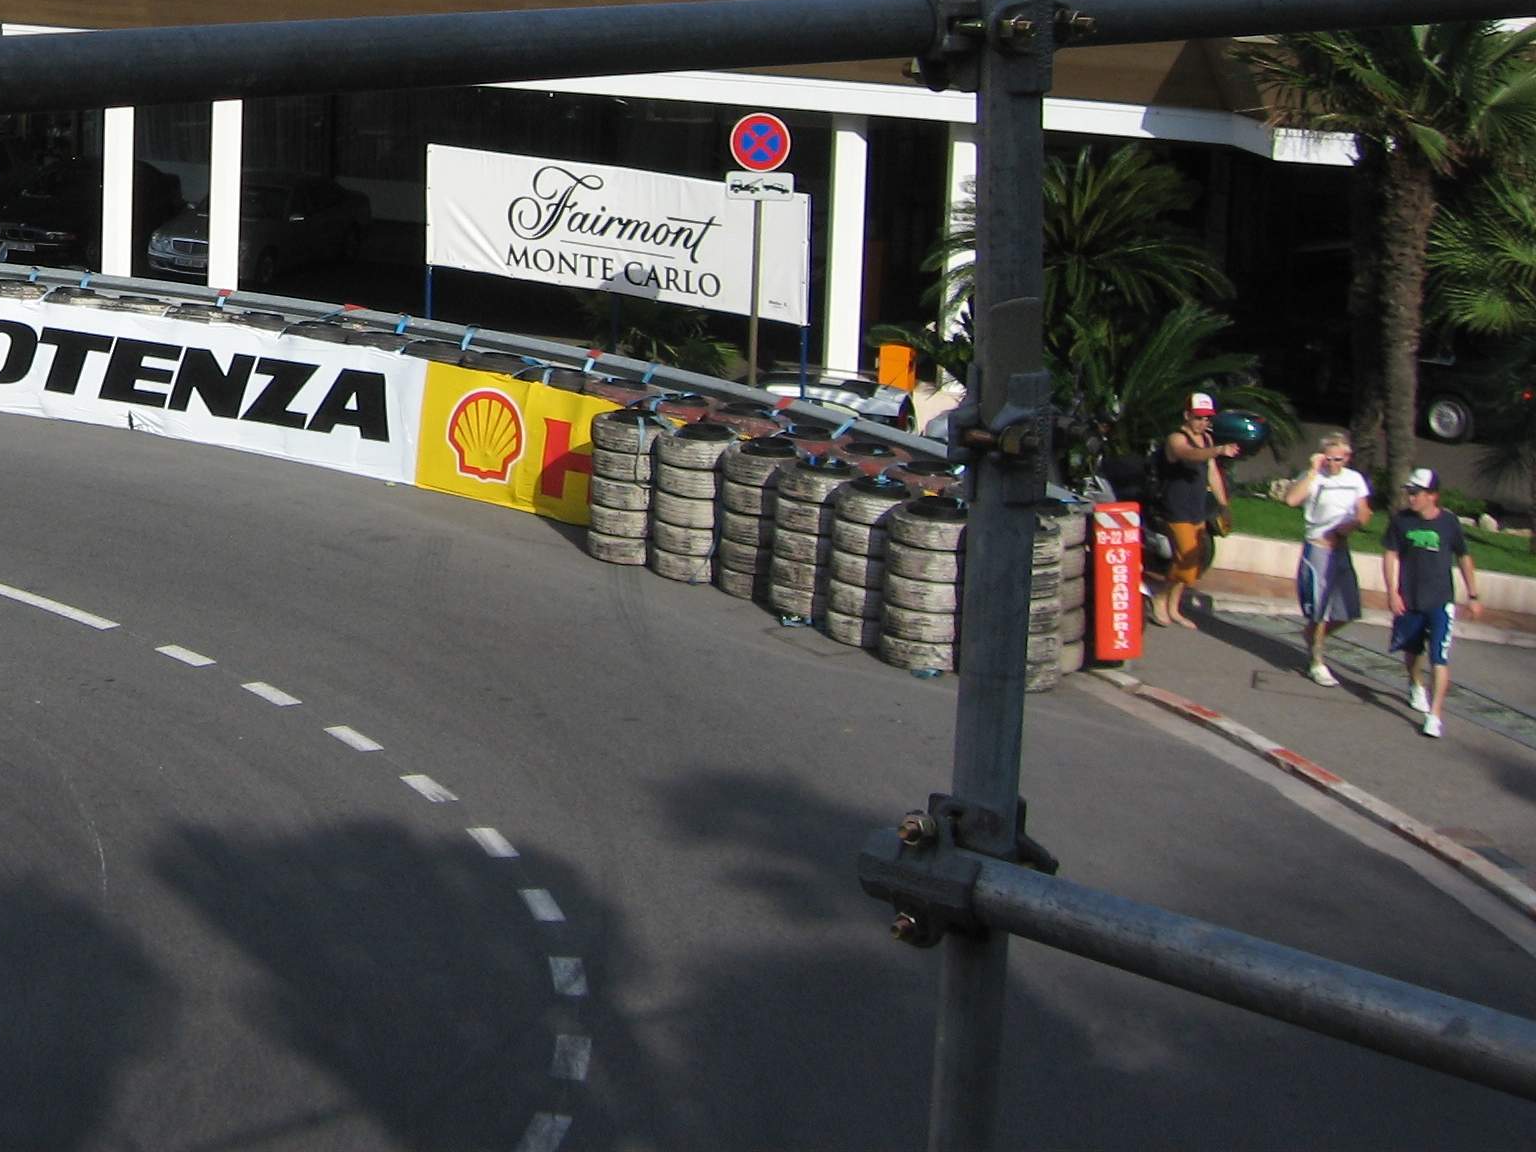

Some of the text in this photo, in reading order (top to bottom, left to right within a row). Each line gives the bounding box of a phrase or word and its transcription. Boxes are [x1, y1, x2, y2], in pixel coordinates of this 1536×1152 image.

[507, 166, 722, 264] Fairmont
[505, 244, 721, 298] MONTE CARLO
[1112, 565, 1129, 649] GRAND PRIX
